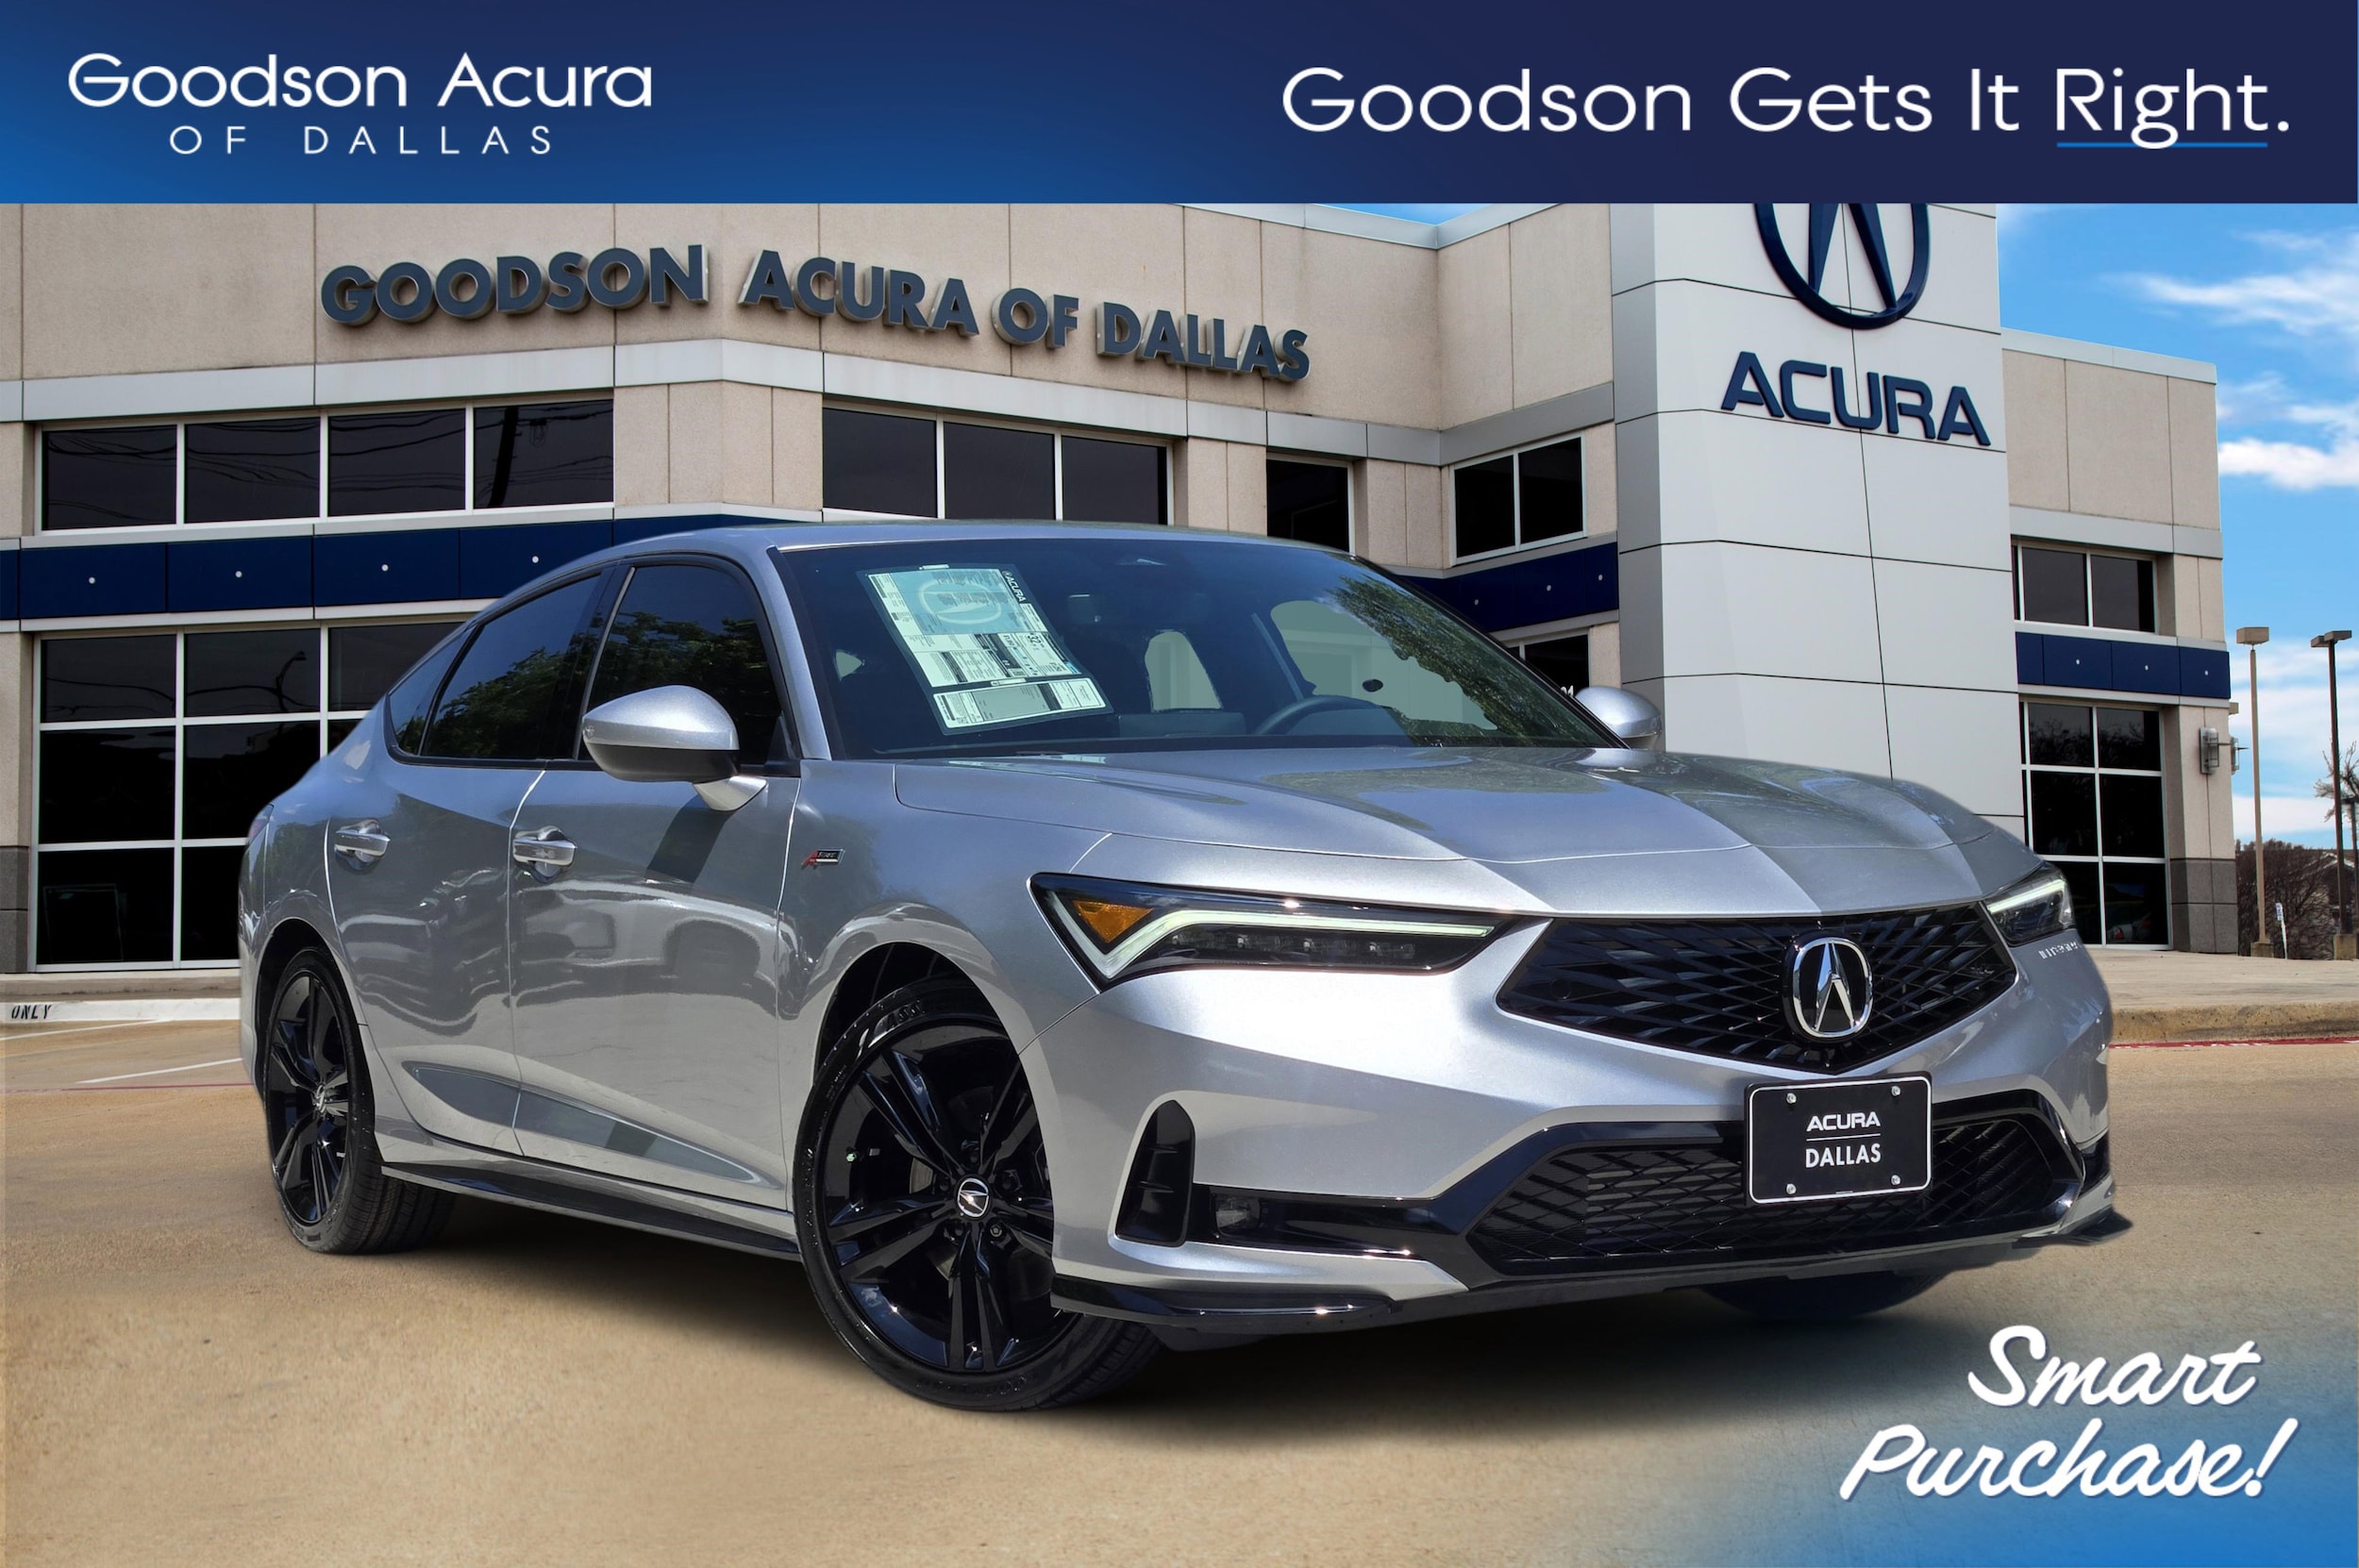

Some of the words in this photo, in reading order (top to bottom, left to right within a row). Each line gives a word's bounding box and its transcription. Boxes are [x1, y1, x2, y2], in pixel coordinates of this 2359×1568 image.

[321, 243, 710, 326] GOODSON
[739, 249, 979, 338] ACURA
[992, 287, 1079, 349] OF
[1096, 301, 1311, 382] DALLAS
[1720, 351, 1992, 446] ACURA
[1004, 575, 1027, 603] ACURA
[10, 1004, 52, 1020] ONLY
[1806, 1110, 1882, 1132] ACURA
[1805, 1143, 1882, 1169] DALLAS
